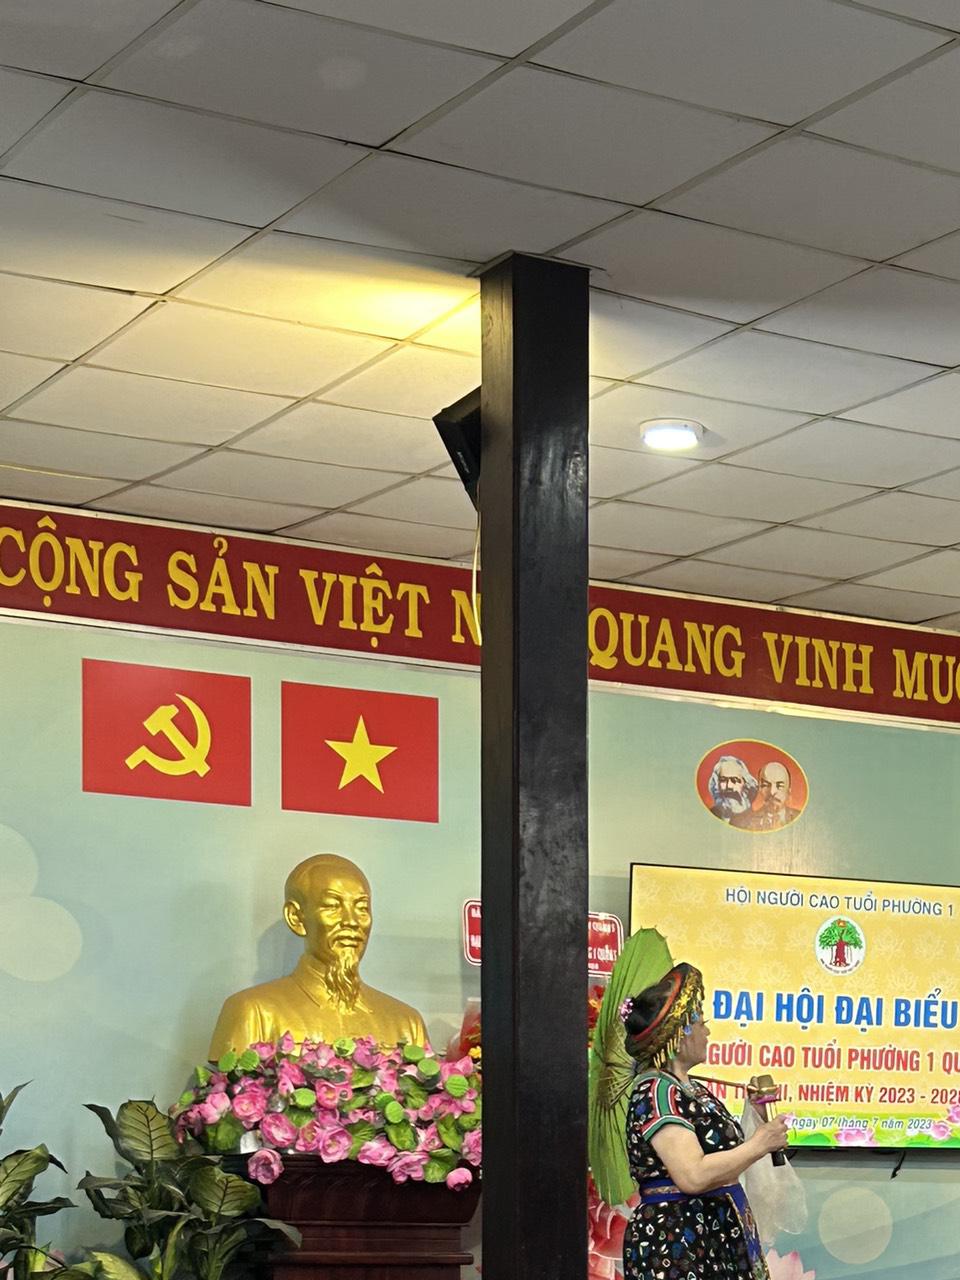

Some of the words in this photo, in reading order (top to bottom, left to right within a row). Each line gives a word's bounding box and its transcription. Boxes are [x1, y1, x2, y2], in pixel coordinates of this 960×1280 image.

[0, 515, 143, 608] CỘNG
[167, 537, 280, 620] SẢN
[300, 563, 430, 648] VIỆT
[588, 607, 746, 678] QUANG
[762, 632, 874, 695] VINH
[757, 889, 804, 907] NGƯỜI
[809, 894, 840, 909] CAO
[845, 891, 877, 912] TUỔI
[882, 898, 942, 916] PHƯỜNG
[947, 904, 953, 917] 1
[713, 990, 764, 1027] ĐẠI
[775, 987, 825, 1030] HỘI
[835, 995, 884, 1032] ĐẠI
[894, 988, 958, 1029] BIỂU
[759, 1045, 795, 1068] CAO
[802, 1039, 841, 1069] TUỔI
[848, 1043, 919, 1072] PHƯỜNG
[926, 1051, 934, 1072] 1
[798, 1081, 849, 1105] NHIỆM
[878, 1087, 915, 1104] 2023
[821, 1116, 835, 1128] 07
[907, 1118, 932, 1130] 2023
